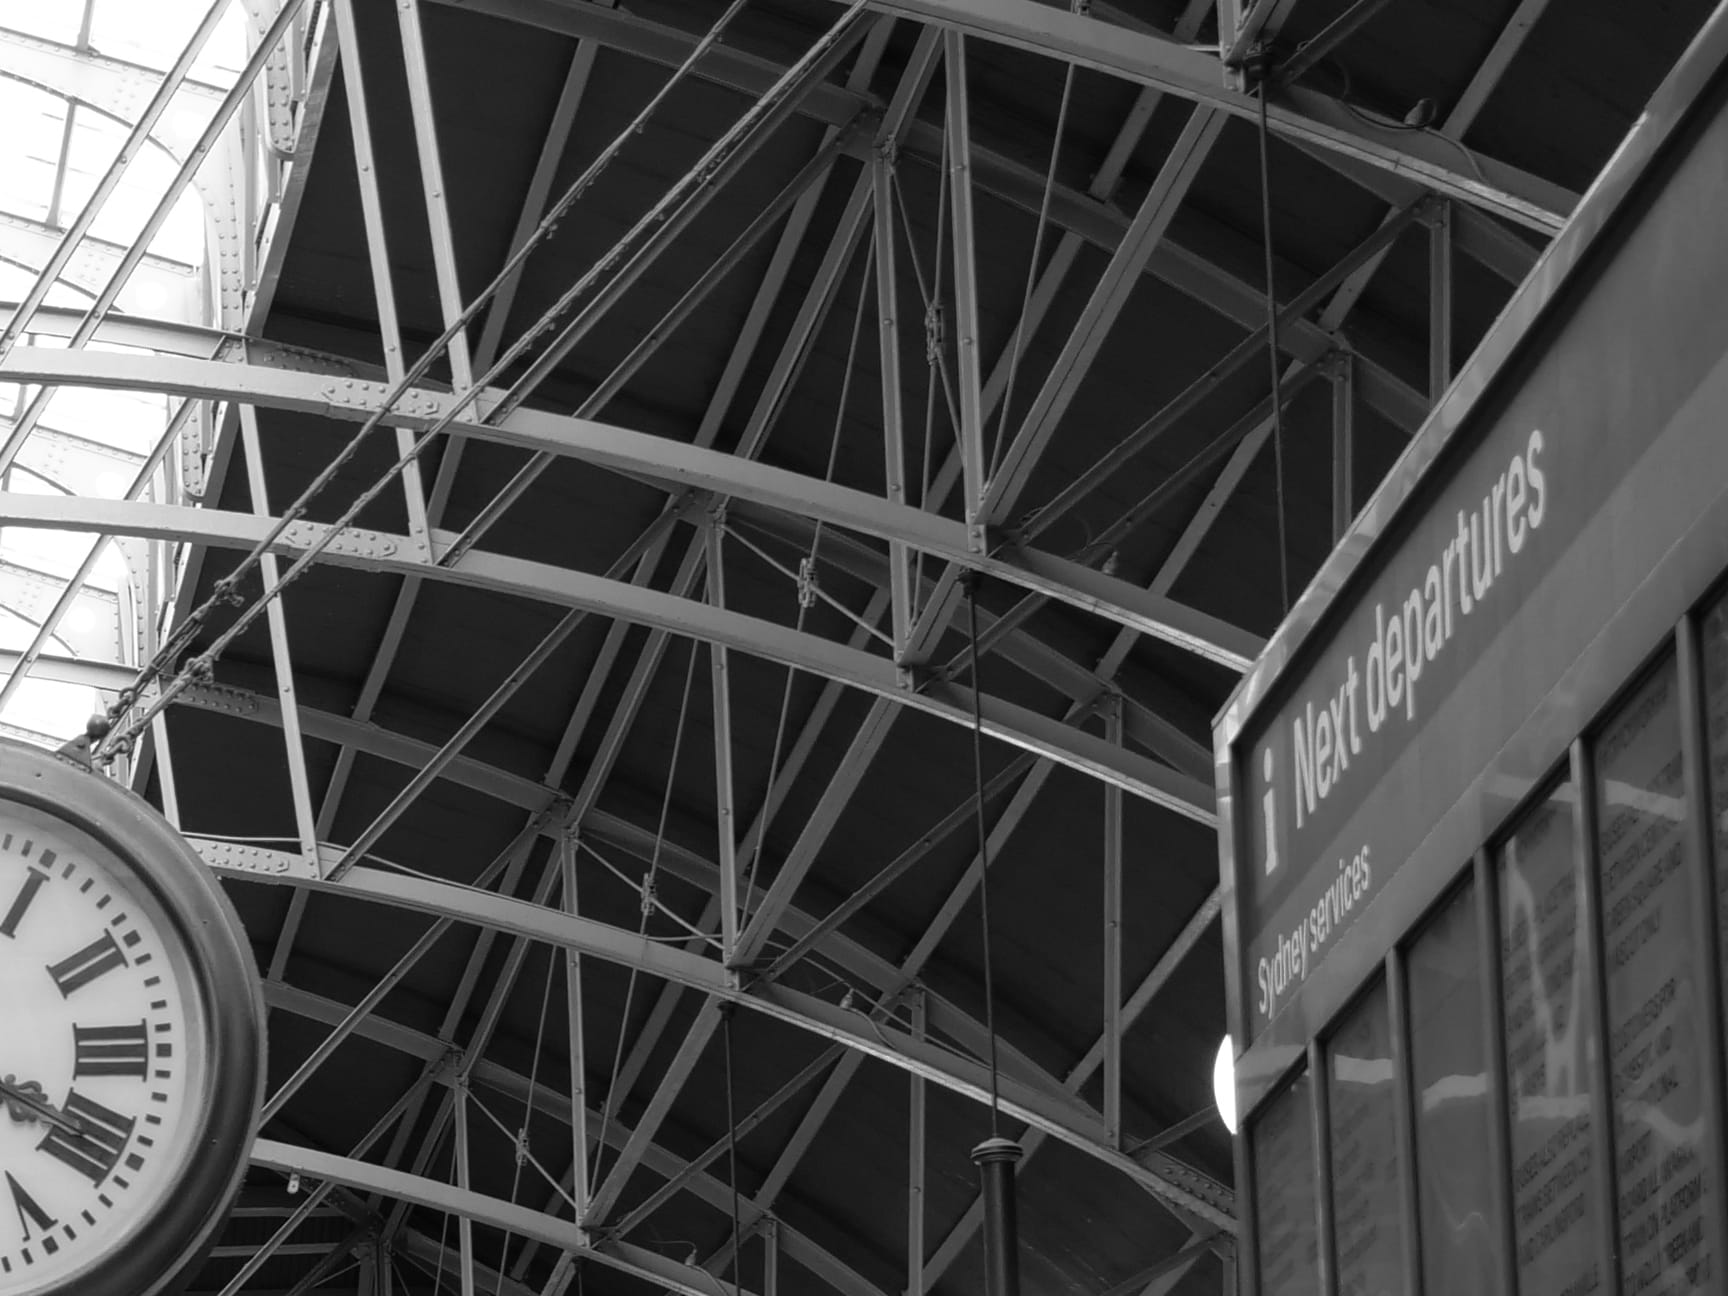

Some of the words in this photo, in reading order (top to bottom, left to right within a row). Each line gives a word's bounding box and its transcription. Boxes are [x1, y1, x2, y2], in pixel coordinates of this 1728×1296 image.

[1292, 655, 1361, 830] Next
[1365, 428, 1544, 735] departures
[1256, 910, 1308, 1018] Sydney
[1309, 843, 1370, 963] services
